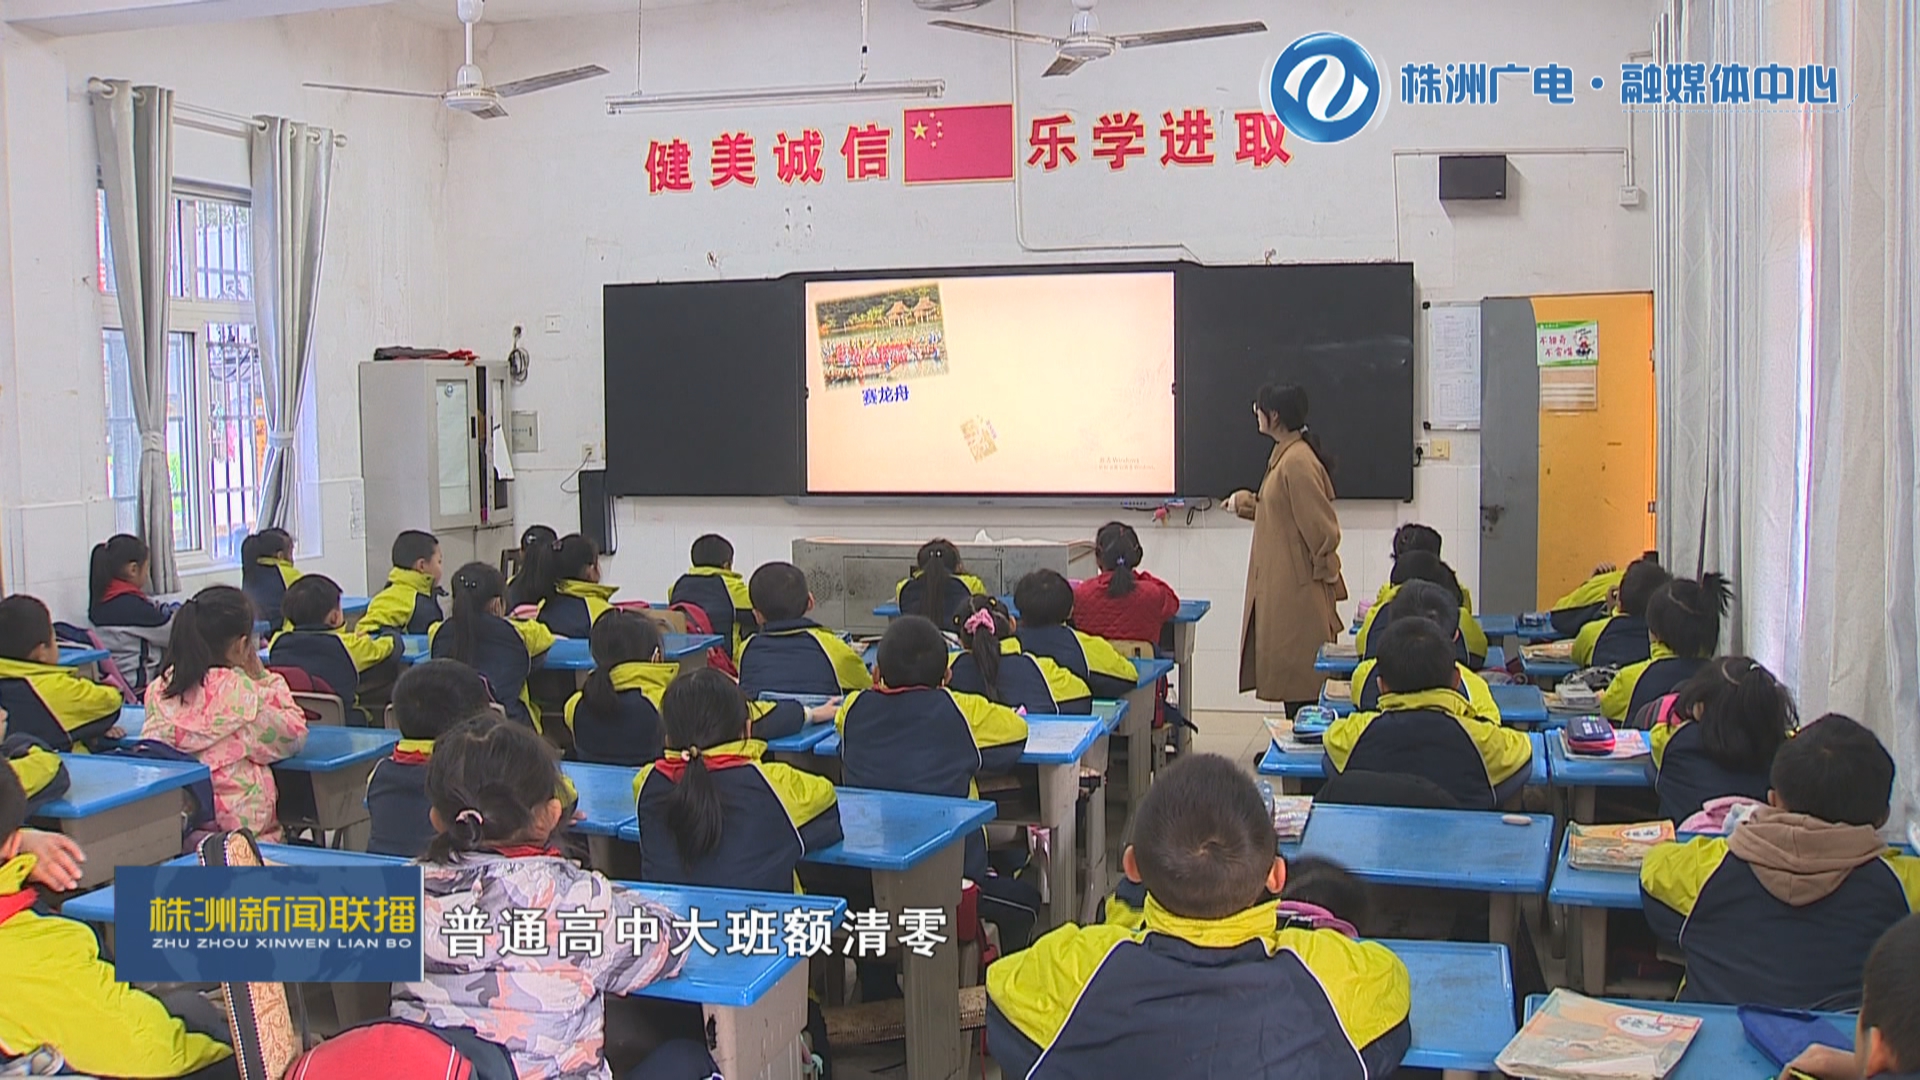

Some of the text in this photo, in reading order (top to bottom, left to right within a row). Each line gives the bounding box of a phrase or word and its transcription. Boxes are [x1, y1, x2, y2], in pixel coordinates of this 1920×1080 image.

[644, 108, 1293, 194] 健美诚信 乐学进取
[862, 384, 909, 406] 赛龙舟
